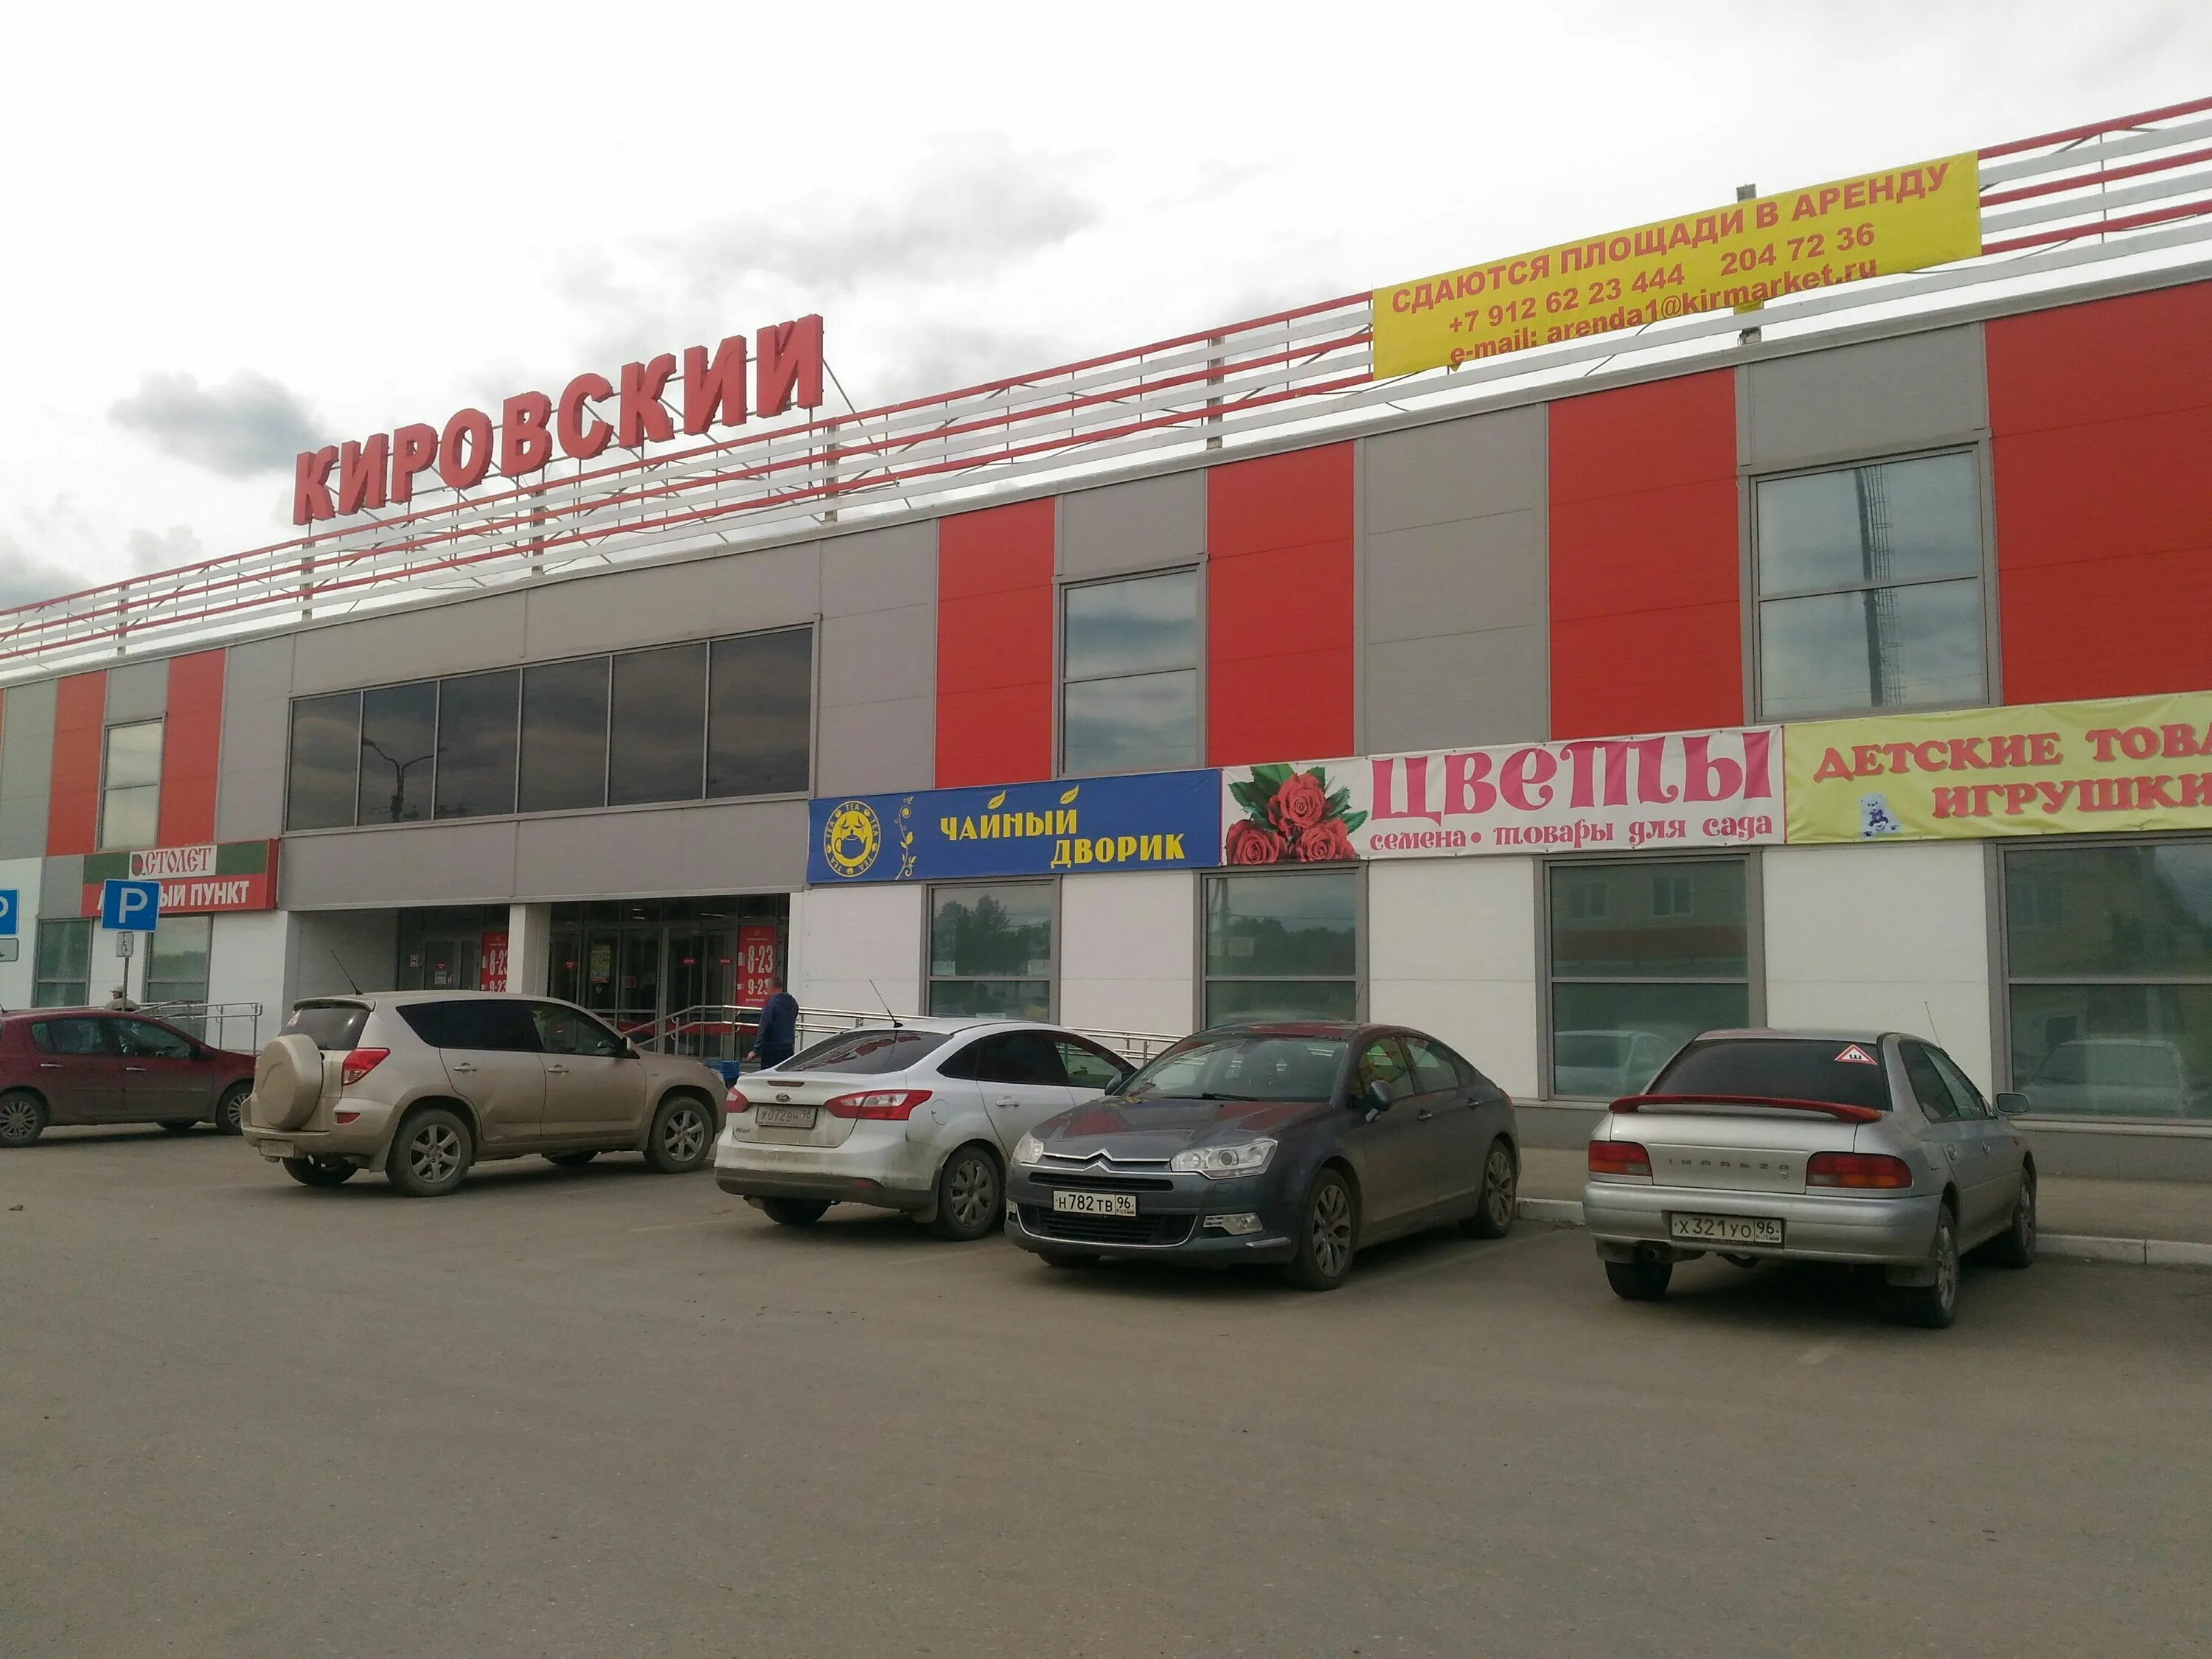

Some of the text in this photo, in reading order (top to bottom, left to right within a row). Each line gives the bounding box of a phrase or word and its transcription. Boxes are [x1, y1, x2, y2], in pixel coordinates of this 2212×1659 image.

[1392, 162, 1949, 313] СДАЮТСЯ ПЛОЩАДИ В АРЕНДУ
[1450, 223, 1875, 333] +7 912 62 23 444 204 72 36
[1450, 259, 1877, 365] e-mail: arenda1@kirmarket.ru
[293, 313, 824, 526] КИРОВСКИЙ
[1812, 731, 2064, 782] ДЕТСКИЕ
[846, 803, 860, 811] TEA
[1932, 772, 2212, 818] ИГРУШКИ
[826, 821, 835, 838] TEA
[871, 818, 879, 836] TEA
[940, 787, 1077, 841] ЧАЙНЫЙ
[1368, 814, 1773, 851] семена товары для сада
[830, 855, 843, 872] TEA
[858, 856, 873, 870] TEA
[1050, 833, 1185, 869] ДВОРИК
[118, 887, 148, 924] P
[189, 880, 250, 906] ПУНКТ
[747, 945, 773, 973] 8-23
